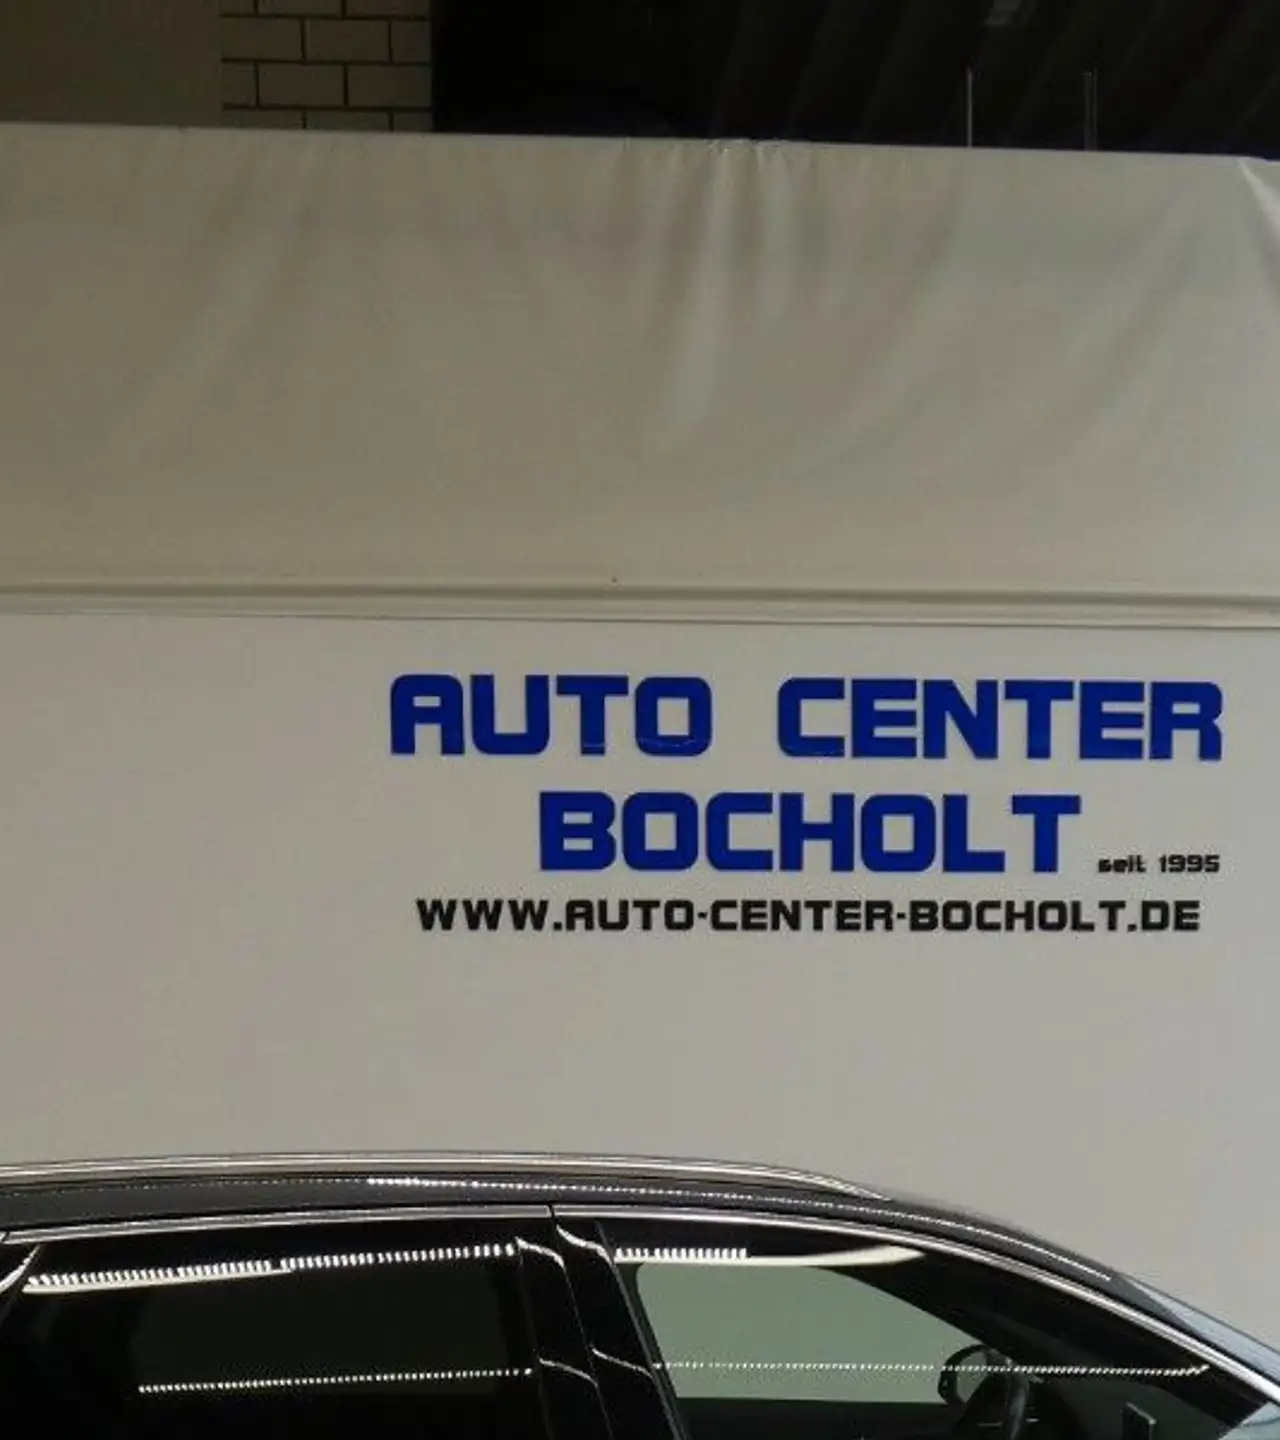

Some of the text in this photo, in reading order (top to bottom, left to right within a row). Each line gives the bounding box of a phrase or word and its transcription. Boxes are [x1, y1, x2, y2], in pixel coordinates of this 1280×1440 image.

[391, 674, 1223, 761] AUTO CENTER
[540, 790, 1221, 874] BOCHOLT seit 1995
[415, 897, 1201, 933] WWW.AUTO-CENTER-BOCHOLT.DE
